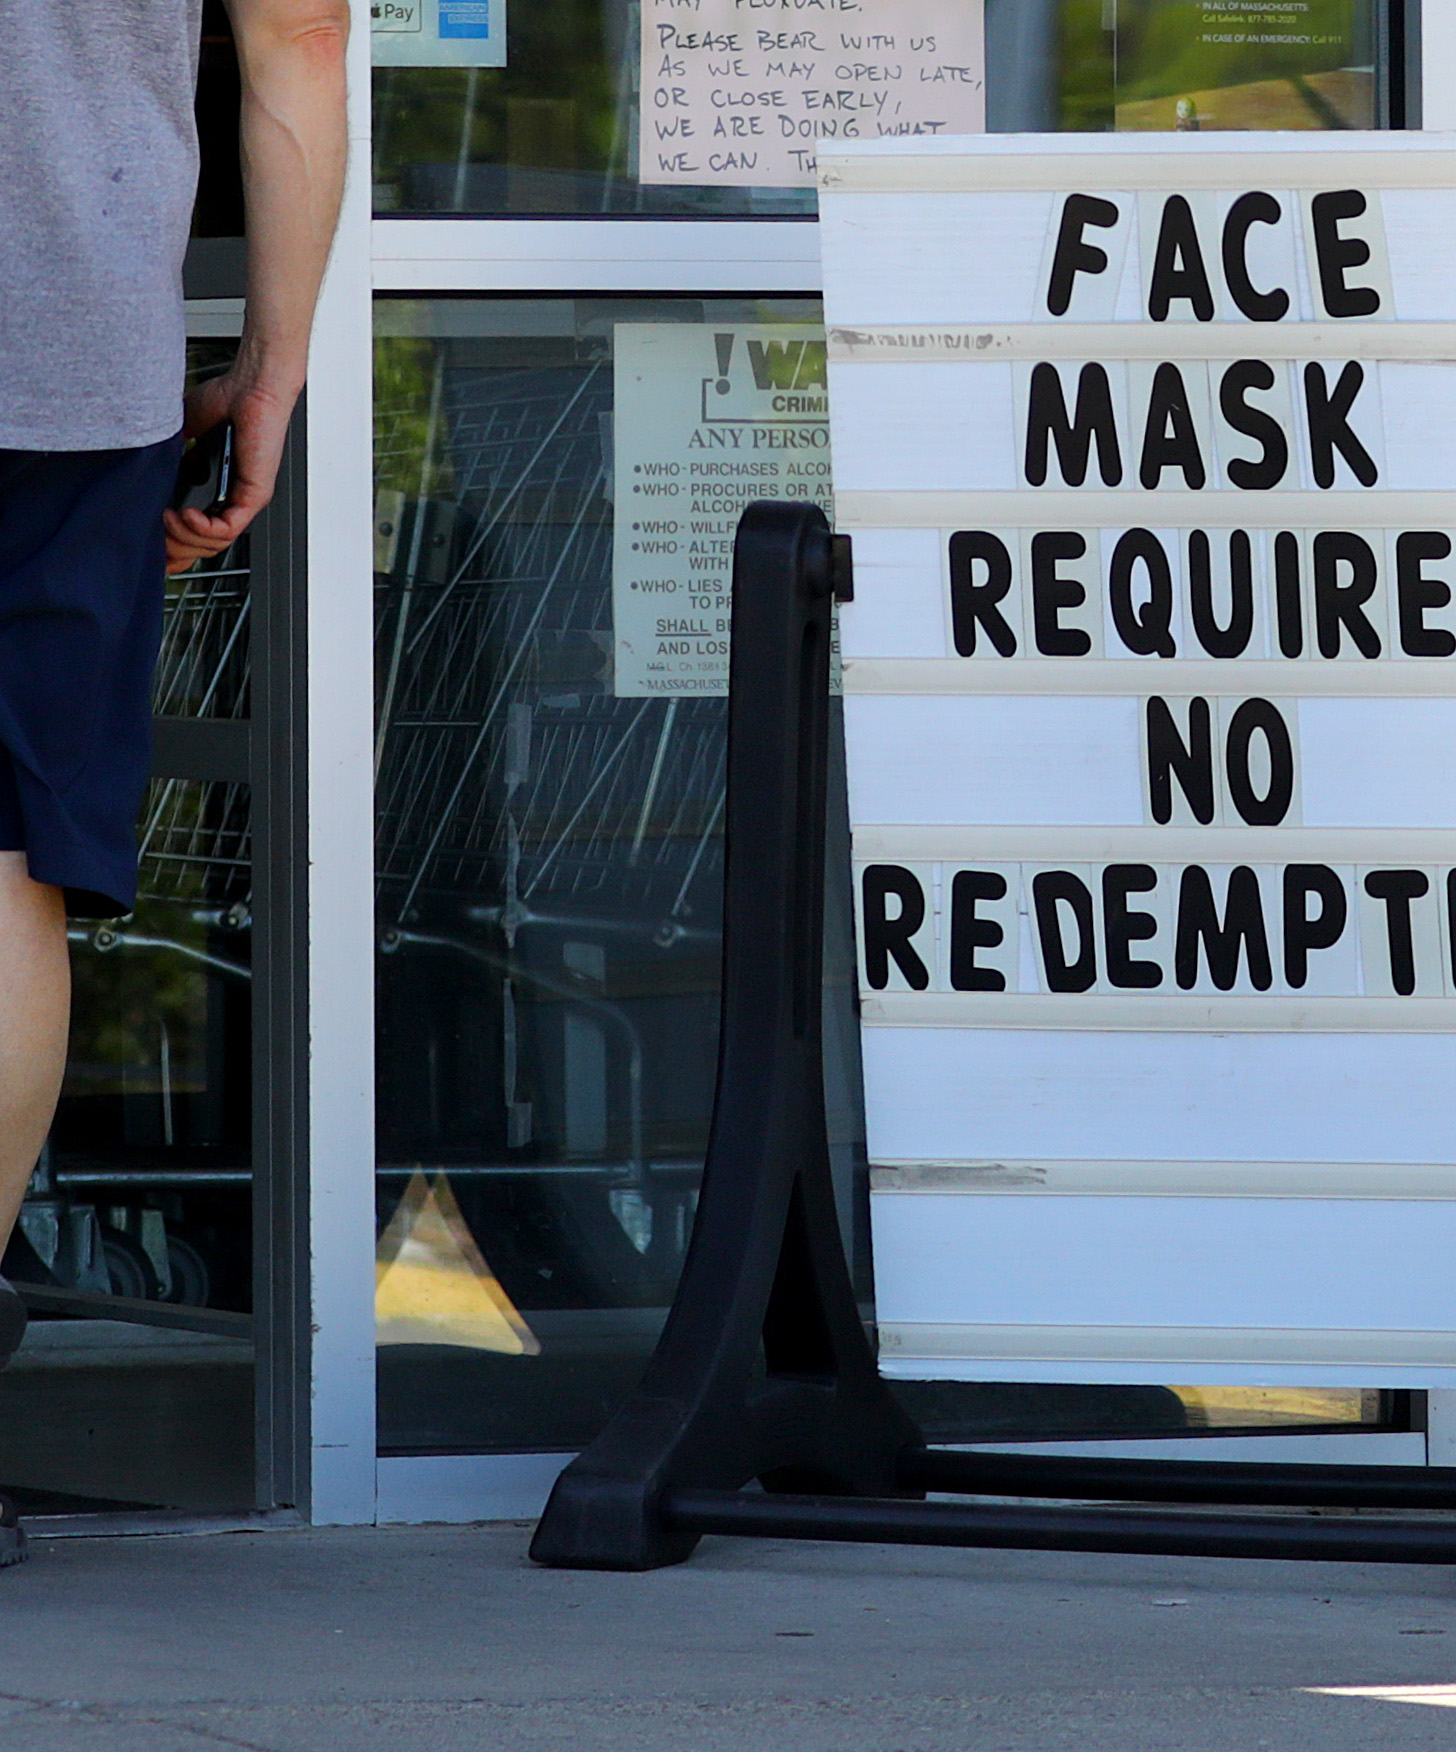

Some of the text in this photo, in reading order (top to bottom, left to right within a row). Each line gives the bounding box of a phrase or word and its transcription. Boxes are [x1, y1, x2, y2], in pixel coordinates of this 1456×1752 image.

[384, 3, 414, 23] Pay
[657, 23, 936, 53] PLEASE BEAR WITH US
[657, 55, 984, 91] AS WE MAY OPEN LATE,
[654, 87, 903, 115] OR CLOSE EARLY,
[655, 114, 947, 140] WE ARE DOING WHAT
[658, 152, 701, 173] WE
[1047, 189, 1381, 322] FACE
[1024, 358, 1379, 490] MASK
[688, 428, 744, 449] ANY
[690, 462, 779, 477] PURCHASES
[690, 483, 808, 497] PROCURES OR
[689, 556, 729, 570] WITH
[656, 618, 709, 633] SHALL
[656, 641, 690, 655] AND
[1146, 694, 1294, 826] NO
